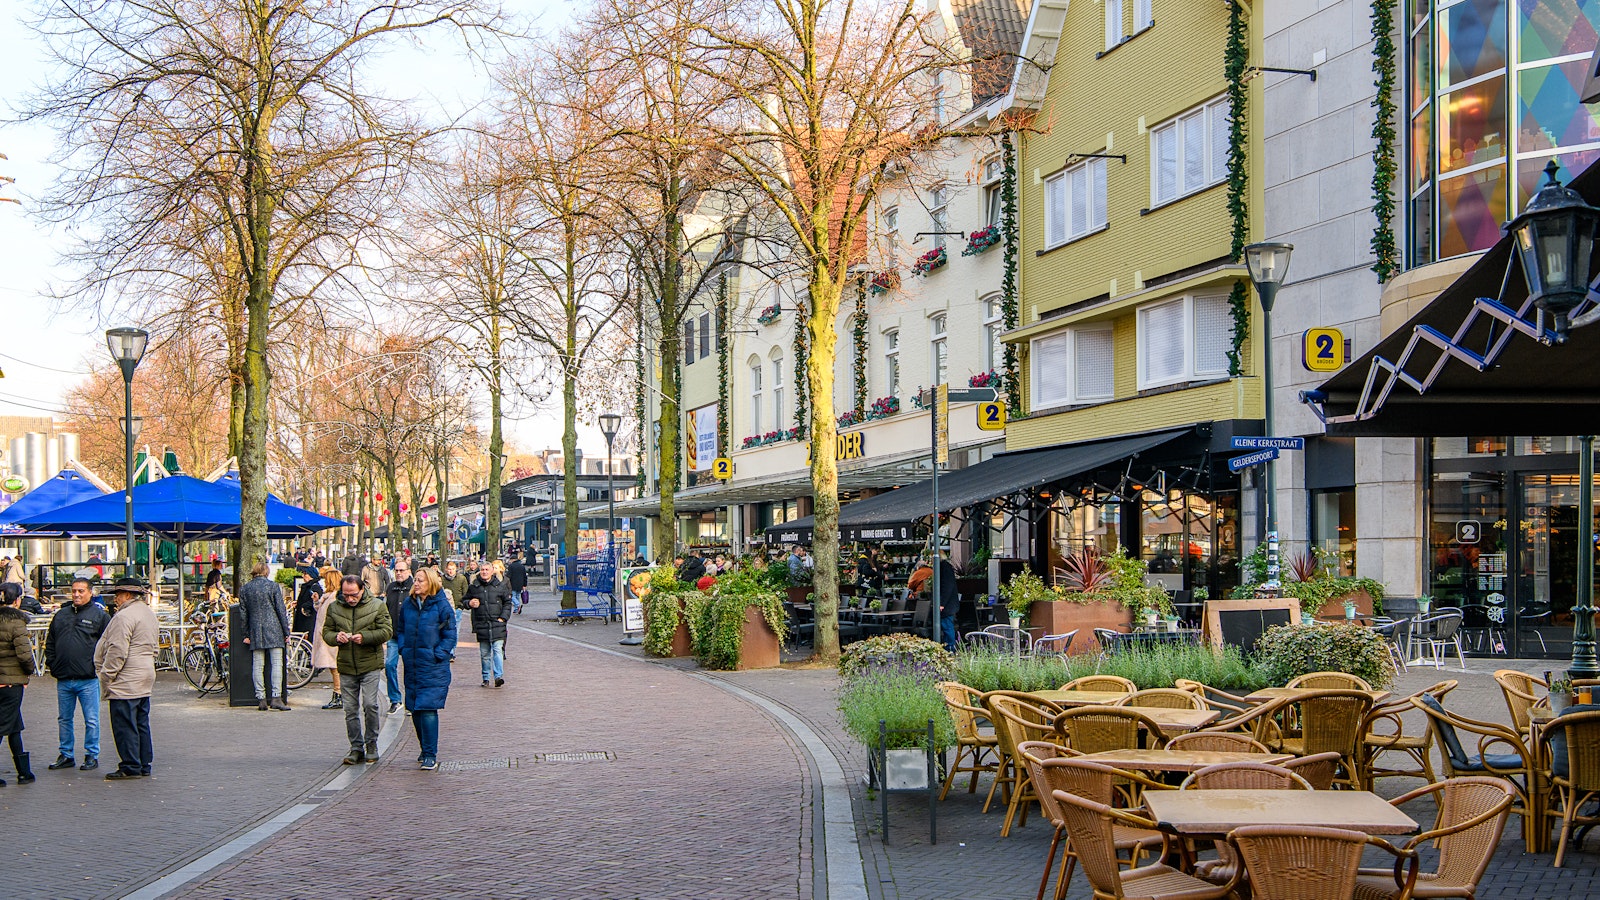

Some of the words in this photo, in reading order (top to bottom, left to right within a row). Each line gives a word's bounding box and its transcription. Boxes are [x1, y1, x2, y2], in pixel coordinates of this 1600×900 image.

[1316, 334, 1334, 358] 2
[986, 405, 999, 421] 2
[1235, 438, 1256, 447] KLEINE
[1258, 440, 1298, 448] KERKSTRAAT
[1233, 451, 1273, 467] GELDERSEPOORT
[718, 461, 728, 473] 2
[875, 529, 893, 538] GERICHTE
[1462, 525, 1475, 539] 2
